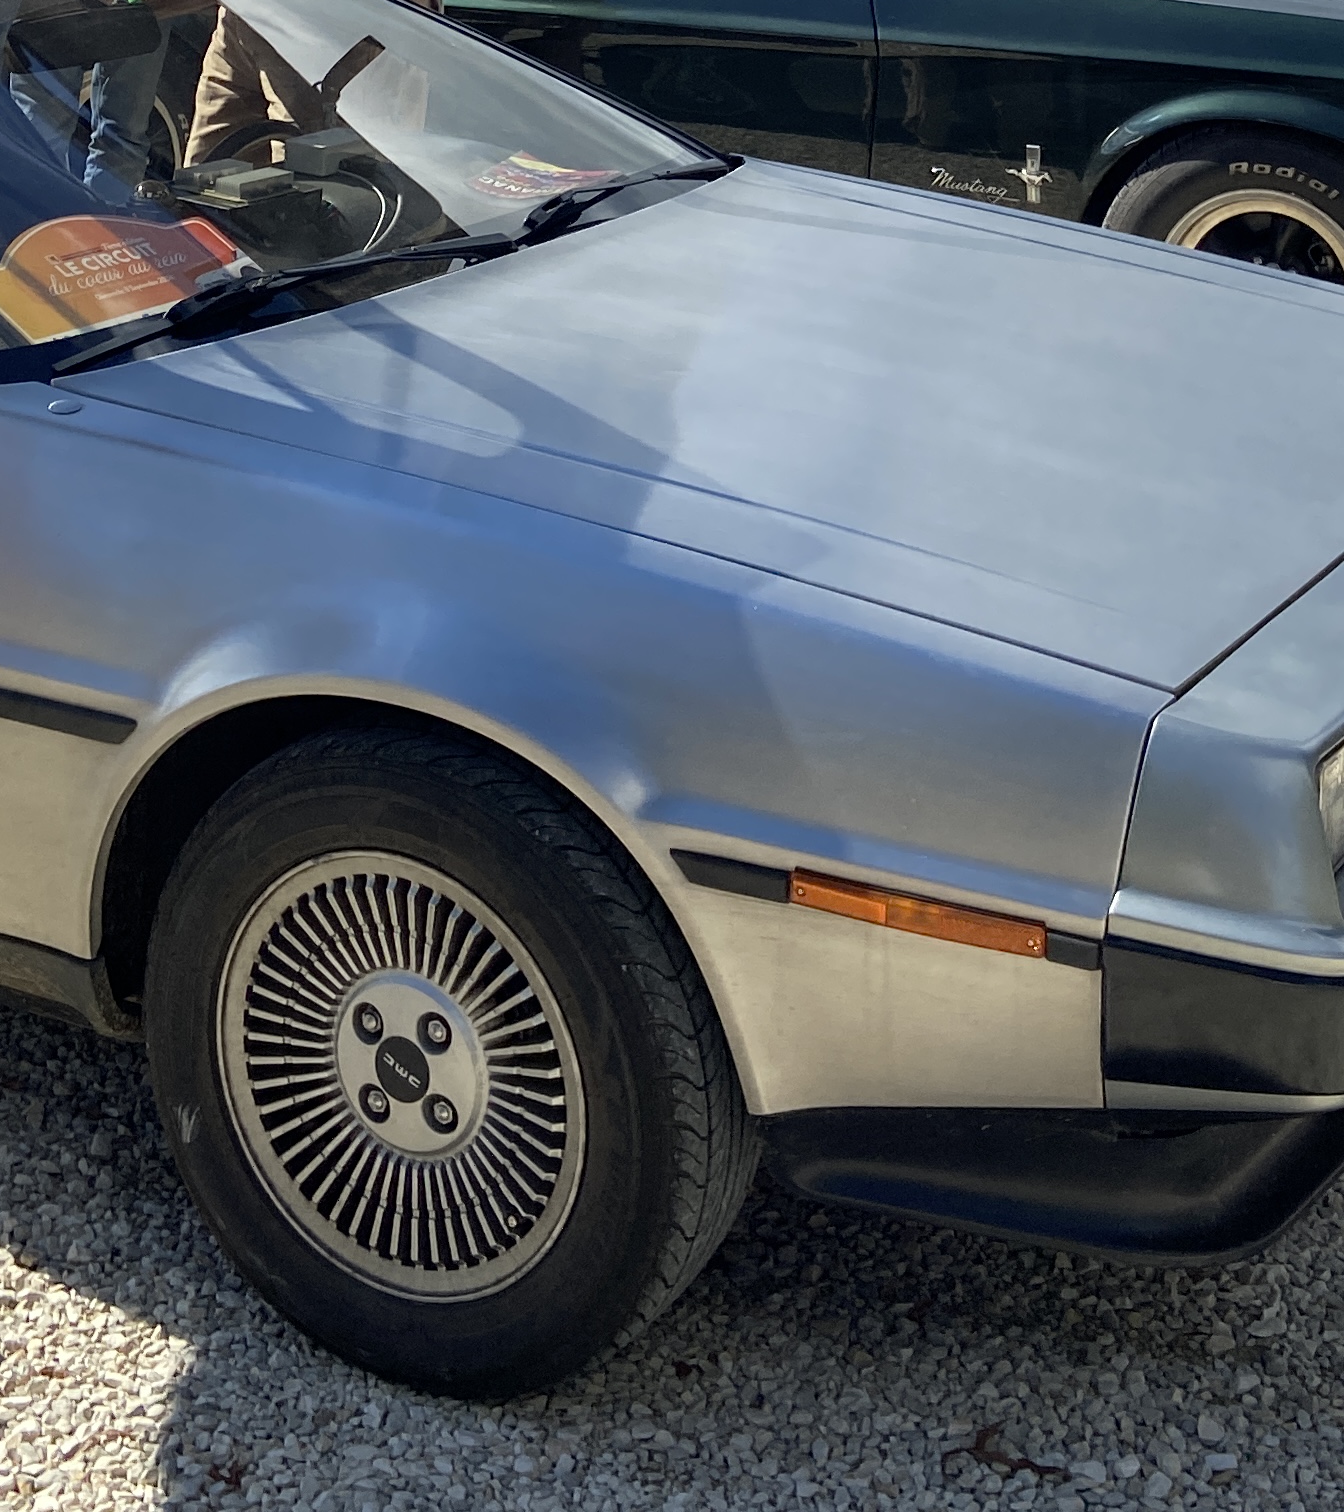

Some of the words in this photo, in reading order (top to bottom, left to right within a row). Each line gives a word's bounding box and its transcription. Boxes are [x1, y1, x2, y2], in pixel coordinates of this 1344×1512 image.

[930, 167, 1020, 204] Mustang
[1229, 161, 1340, 200] Radial
[48, 273, 73, 296] du
[76, 269, 125, 290] coeur
[127, 261, 151, 276] au
[155, 251, 187, 269] rein
[54, 261, 85, 278] LE
[82, 242, 158, 272] CIRCUIT
